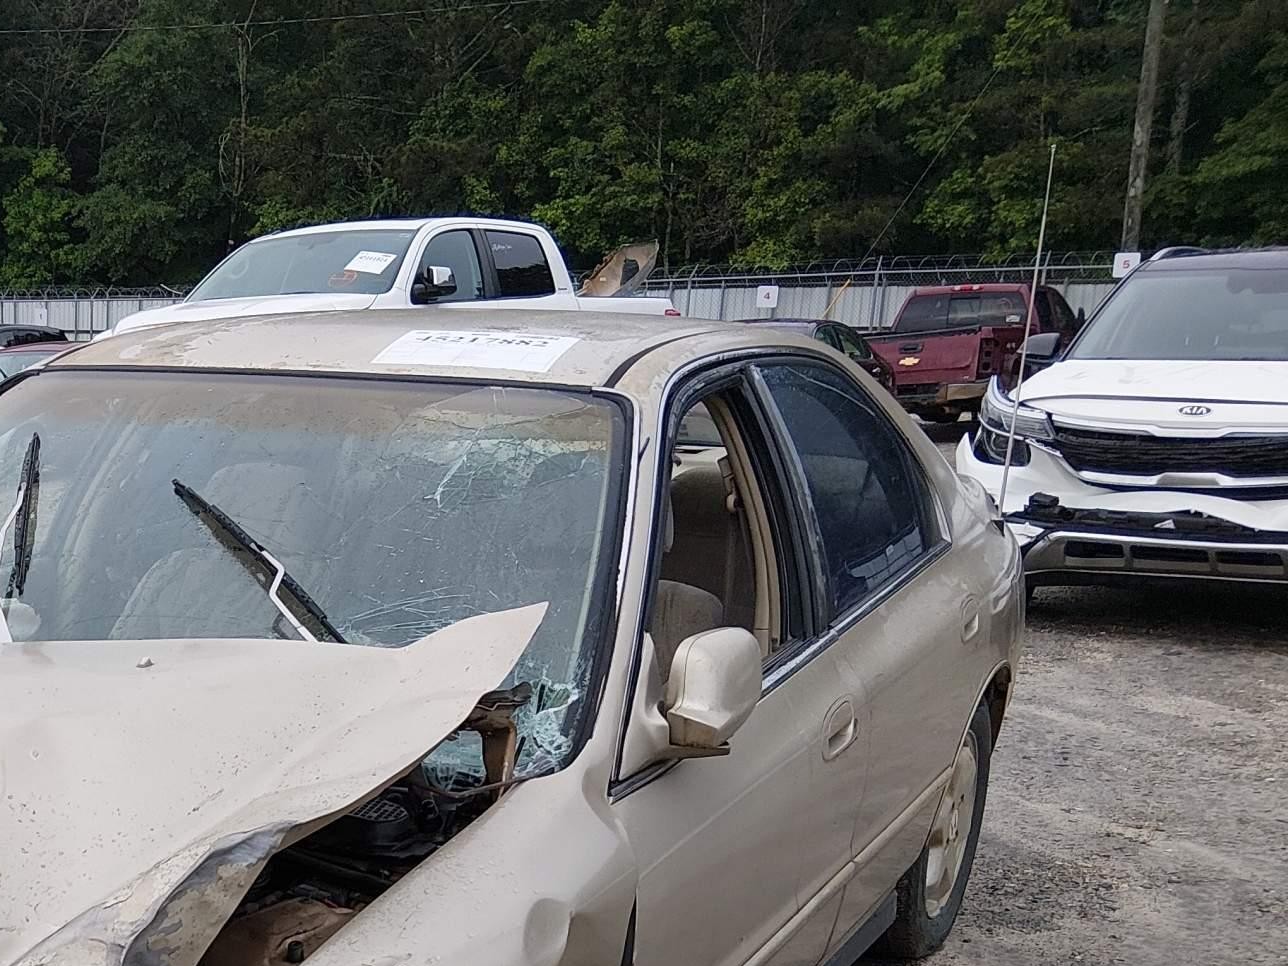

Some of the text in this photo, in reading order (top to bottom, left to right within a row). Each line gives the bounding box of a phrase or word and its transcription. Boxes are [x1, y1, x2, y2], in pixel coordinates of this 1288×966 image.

[1123, 260, 1130, 269] 5
[763, 291, 771, 300] 4
[1181, 406, 1208, 415] KIA
